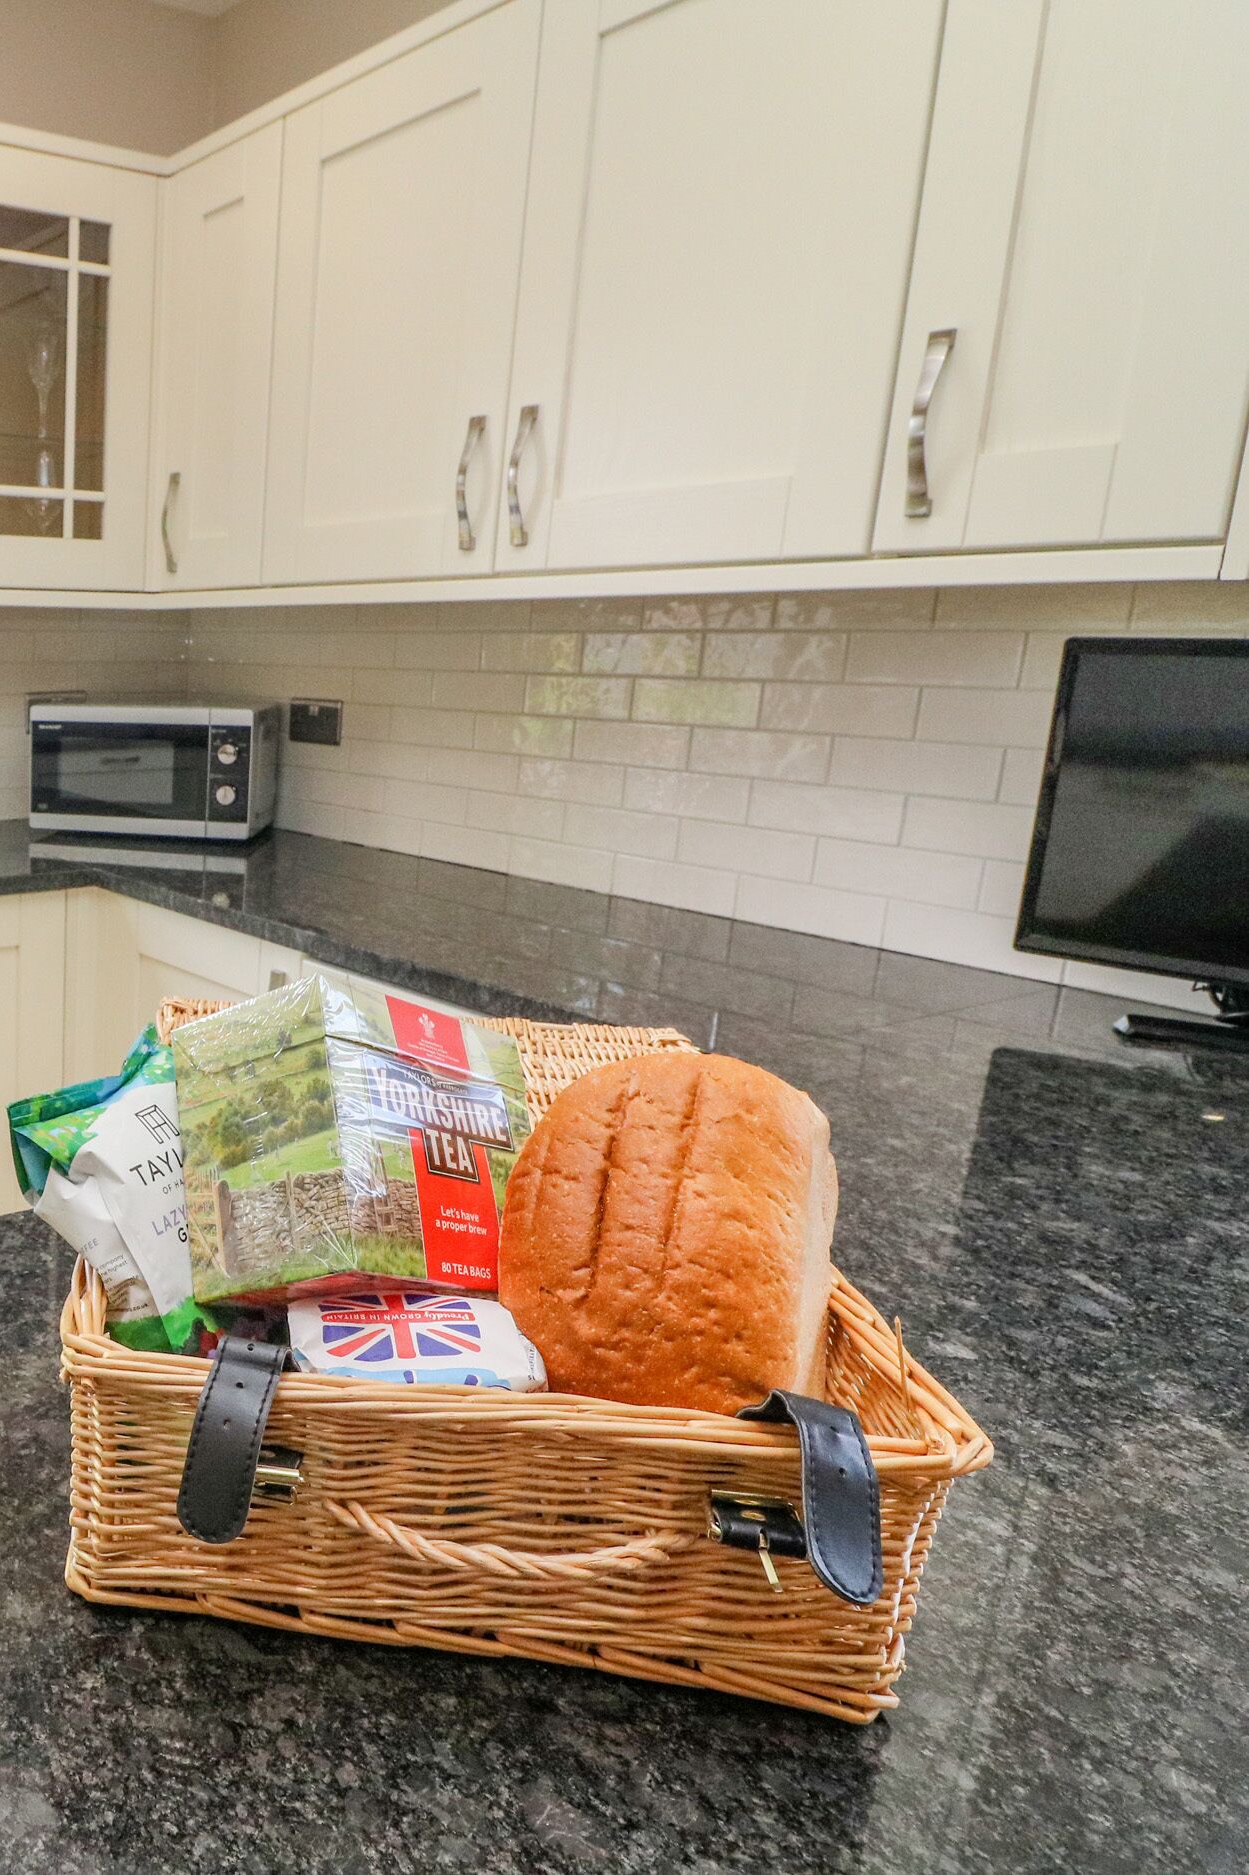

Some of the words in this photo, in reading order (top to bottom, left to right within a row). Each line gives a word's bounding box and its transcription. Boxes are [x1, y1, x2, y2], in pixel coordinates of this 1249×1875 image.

[404, 1069, 436, 1087] TAYLORS
[372, 1066, 507, 1142] YORKSHIRE
[426, 1128, 474, 1174] TEA
[162, 1184, 172, 1195] OF
[152, 1204, 187, 1236] LAZY
[440, 1205, 460, 1219] Let's
[461, 1209, 479, 1222] have
[435, 1219, 441, 1228] a
[442, 1219, 467, 1232] proper
[468, 1222, 487, 1235] brew
[441, 1261, 452, 1274] 80
[452, 1263, 469, 1276] TEA
[470, 1265, 492, 1279] BAGS
[326, 1313, 368, 1321] BRITAIN
[369, 1312, 381, 1321] IN
[384, 1311, 422, 1320] GROWN
[424, 1310, 470, 1321] Proudly
